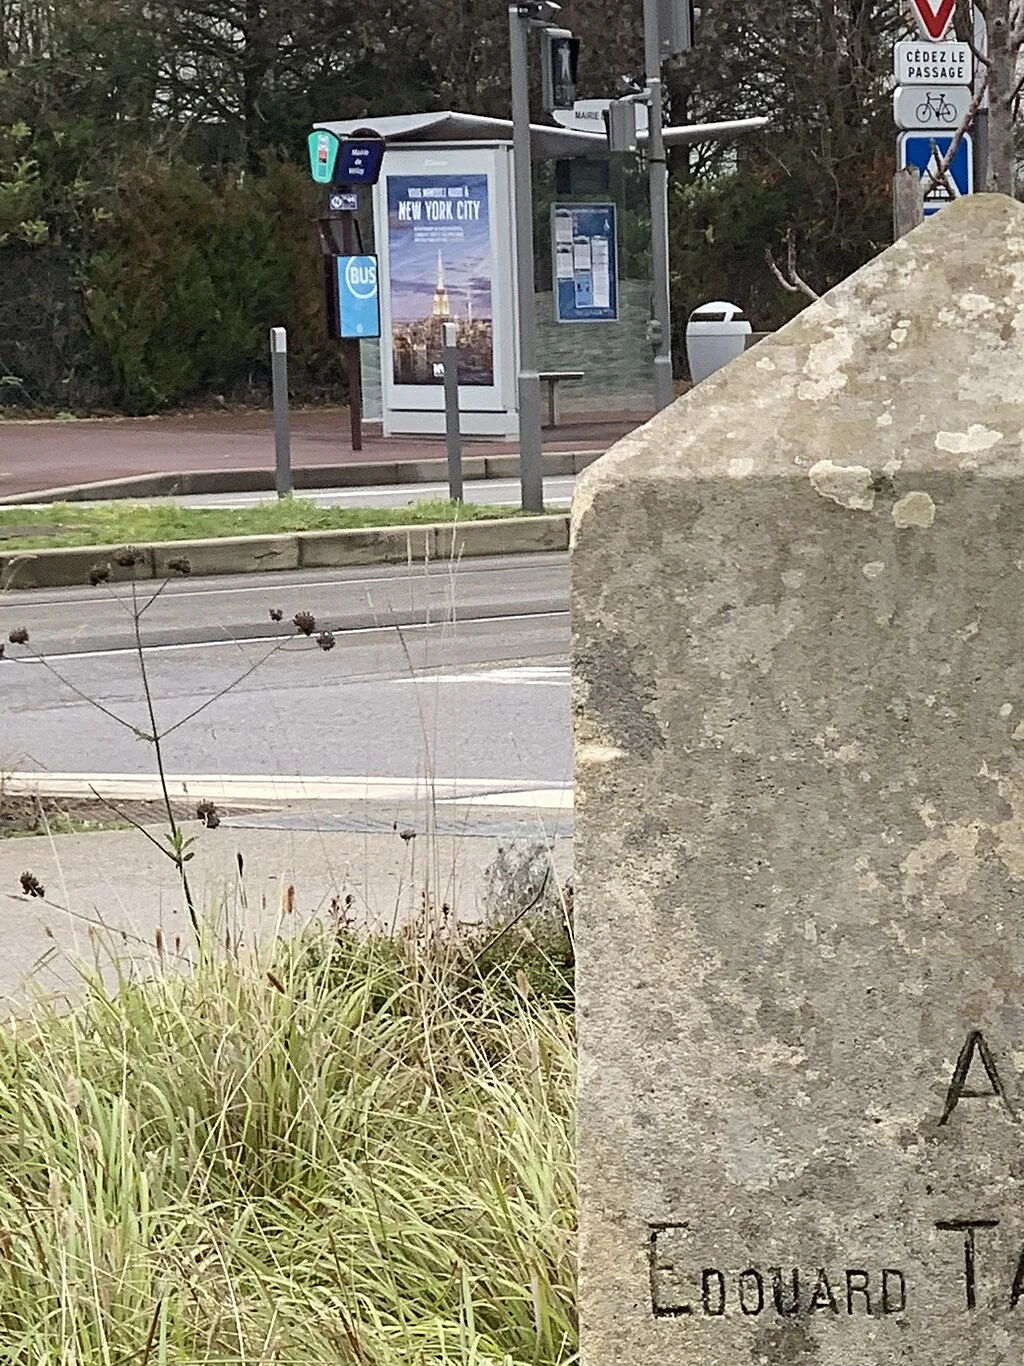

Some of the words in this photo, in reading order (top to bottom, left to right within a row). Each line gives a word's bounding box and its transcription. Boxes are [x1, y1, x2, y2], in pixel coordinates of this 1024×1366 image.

[906, 49, 946, 63] CÉDEZ
[951, 51, 965, 63] LE
[908, 67, 964, 78] PASSAGE
[574, 111, 599, 120] MAIRIE
[398, 200, 422, 221] NEW
[424, 200, 454, 221] YORK
[456, 200, 481, 221] CITY
[350, 266, 377, 285] BUS
[937, 1029, 1020, 1127] A
